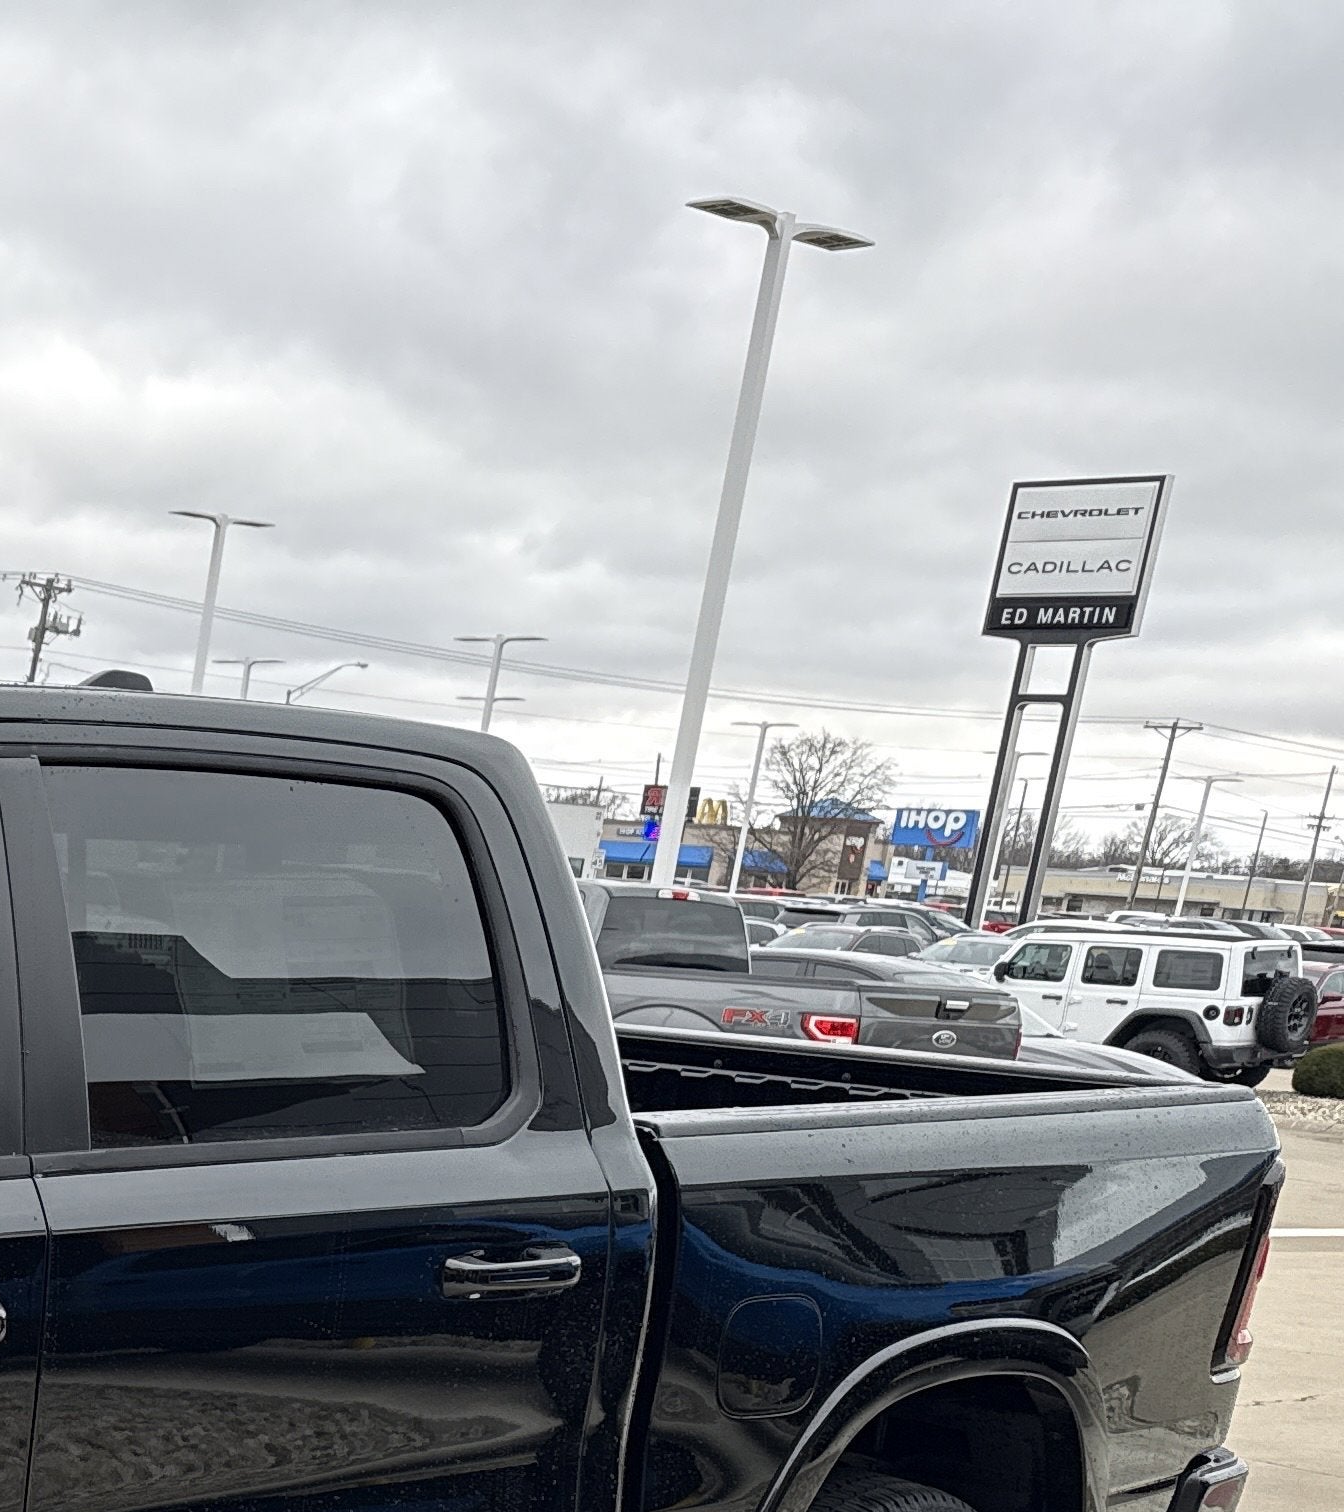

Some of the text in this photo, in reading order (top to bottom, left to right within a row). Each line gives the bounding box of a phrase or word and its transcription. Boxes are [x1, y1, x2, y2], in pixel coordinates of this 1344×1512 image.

[1016, 506, 1145, 520] CHEVROLET
[1007, 559, 1133, 575] CADILLAC
[1000, 606, 1117, 625] ED MARTIN
[900, 809, 967, 838] IHOP
[720, 1006, 791, 1026] FX4
